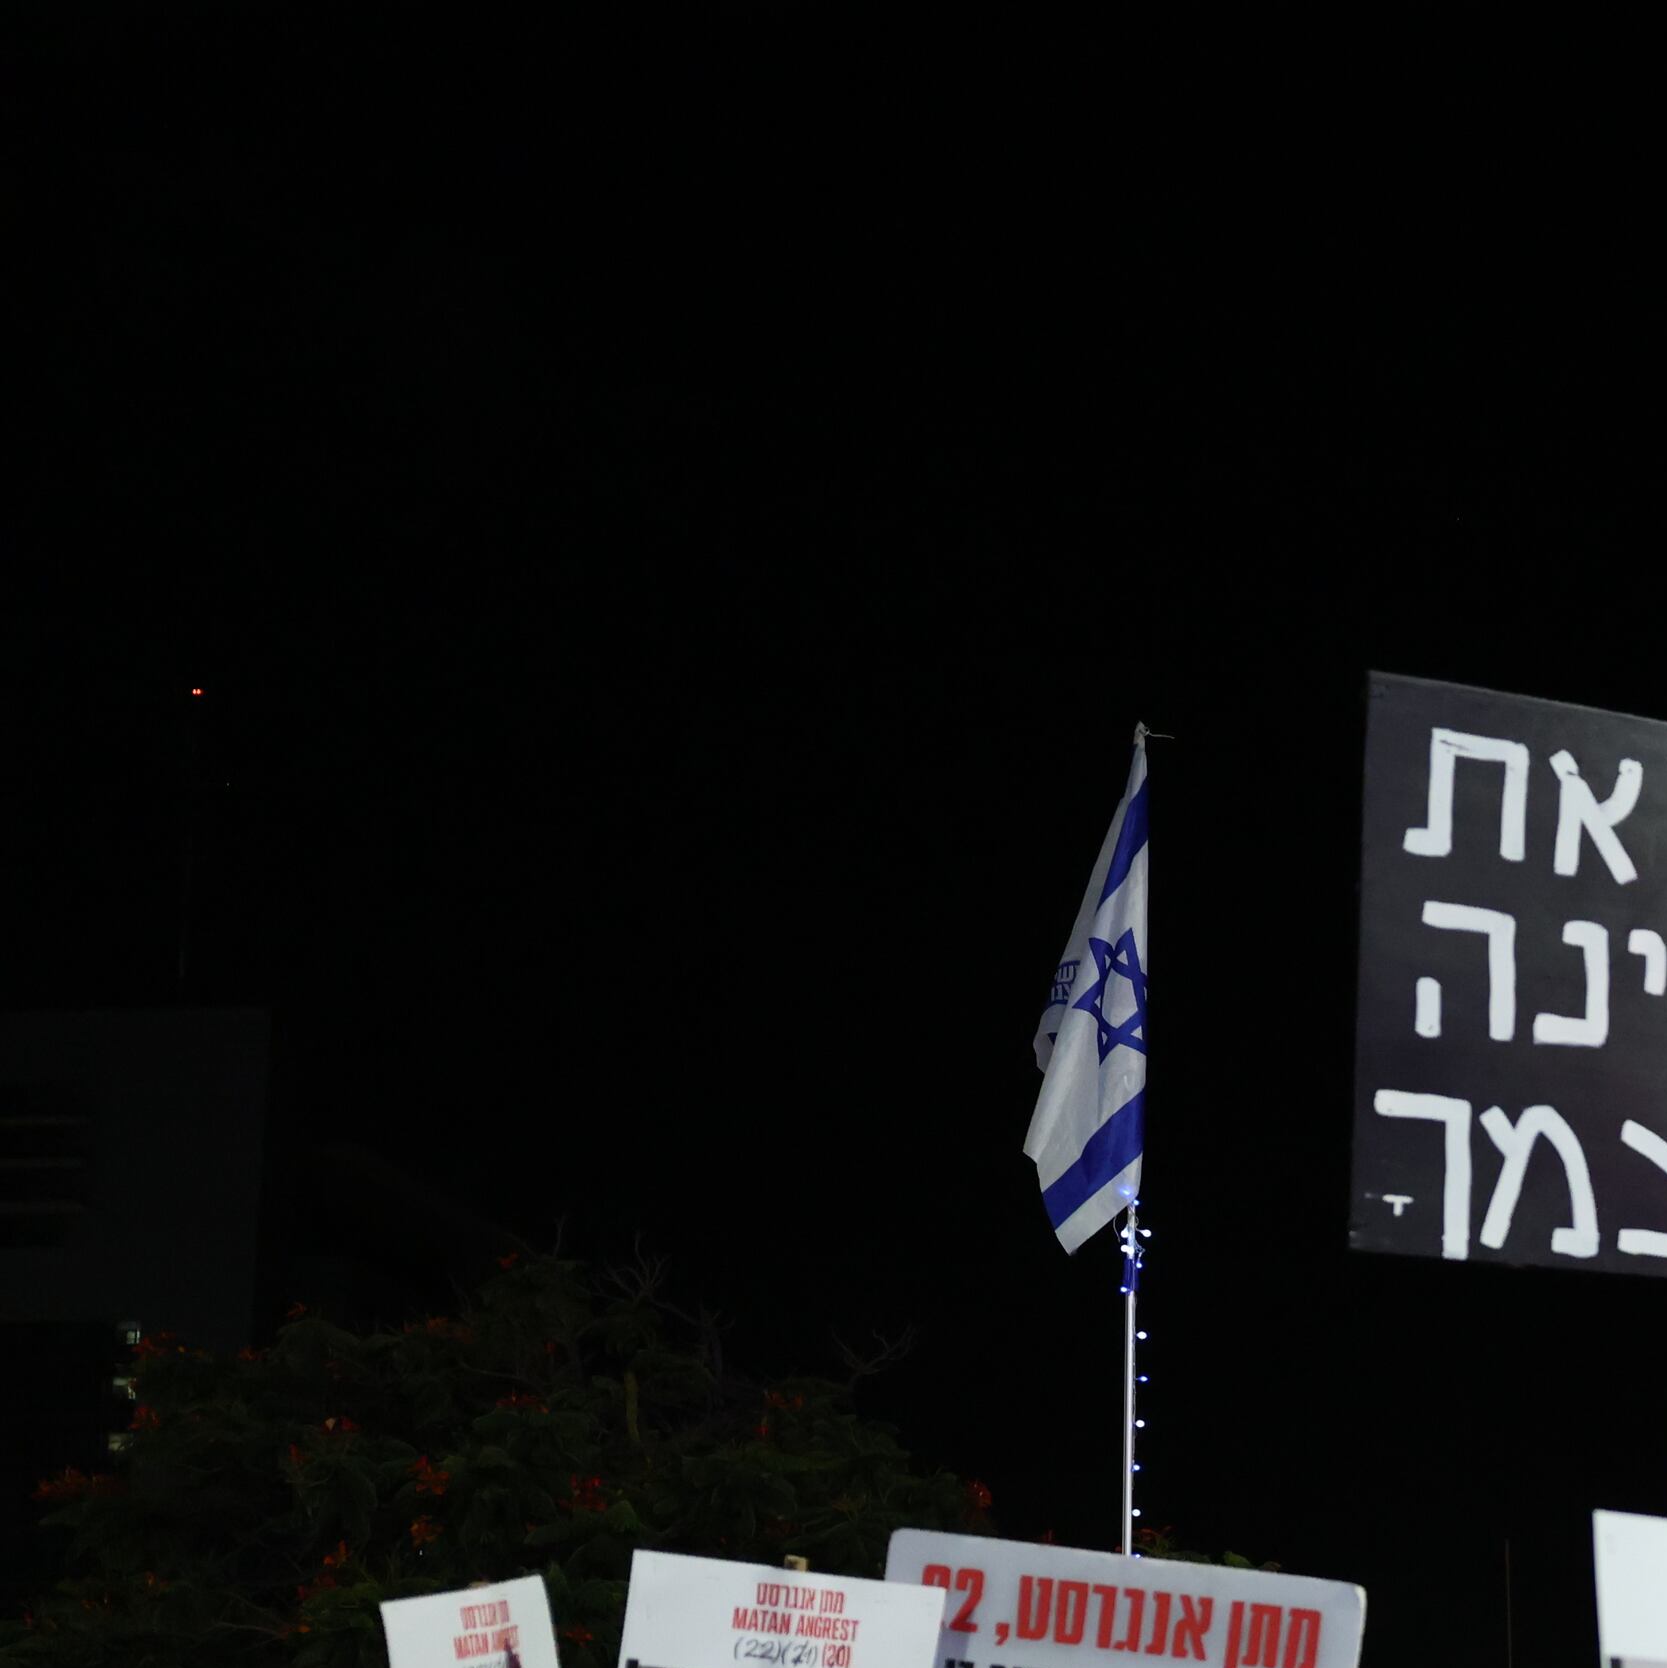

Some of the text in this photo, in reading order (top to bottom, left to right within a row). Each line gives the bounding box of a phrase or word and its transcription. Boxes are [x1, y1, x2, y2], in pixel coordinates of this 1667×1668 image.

[1403, 728, 1643, 884] את
[731, 1605, 860, 1642] MATAN ANGREST
[819, 1588, 845, 1613] מתן
[994, 1574, 1213, 1662] אנגרסט,
